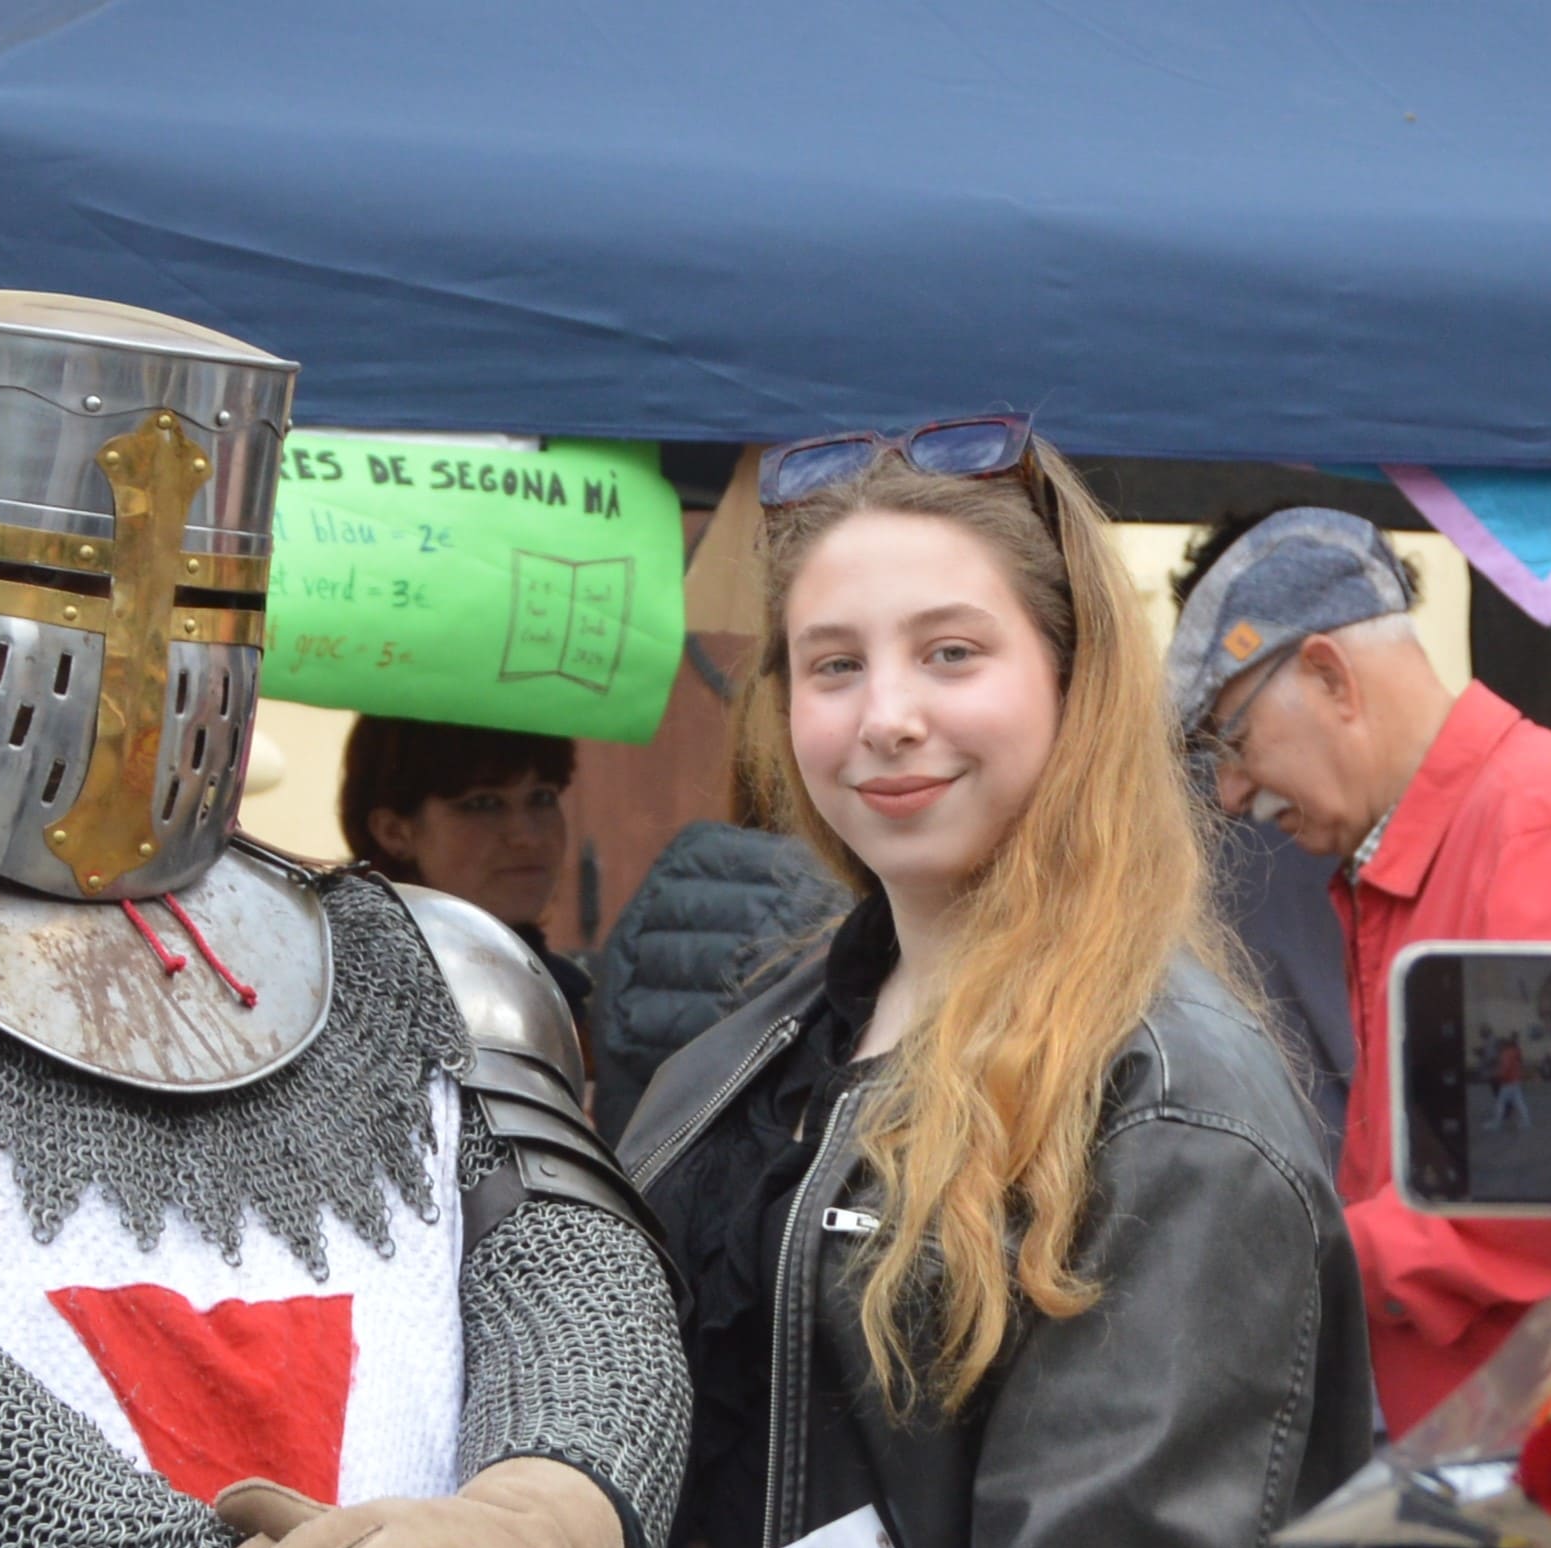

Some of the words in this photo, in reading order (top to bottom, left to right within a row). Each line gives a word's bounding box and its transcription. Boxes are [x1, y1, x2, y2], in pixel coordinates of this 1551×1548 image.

[367, 453, 414, 487] DE
[430, 459, 568, 508] SEGONA
[310, 508, 377, 545] blau
[303, 563, 357, 603] verd
[289, 634, 347, 675] groc
